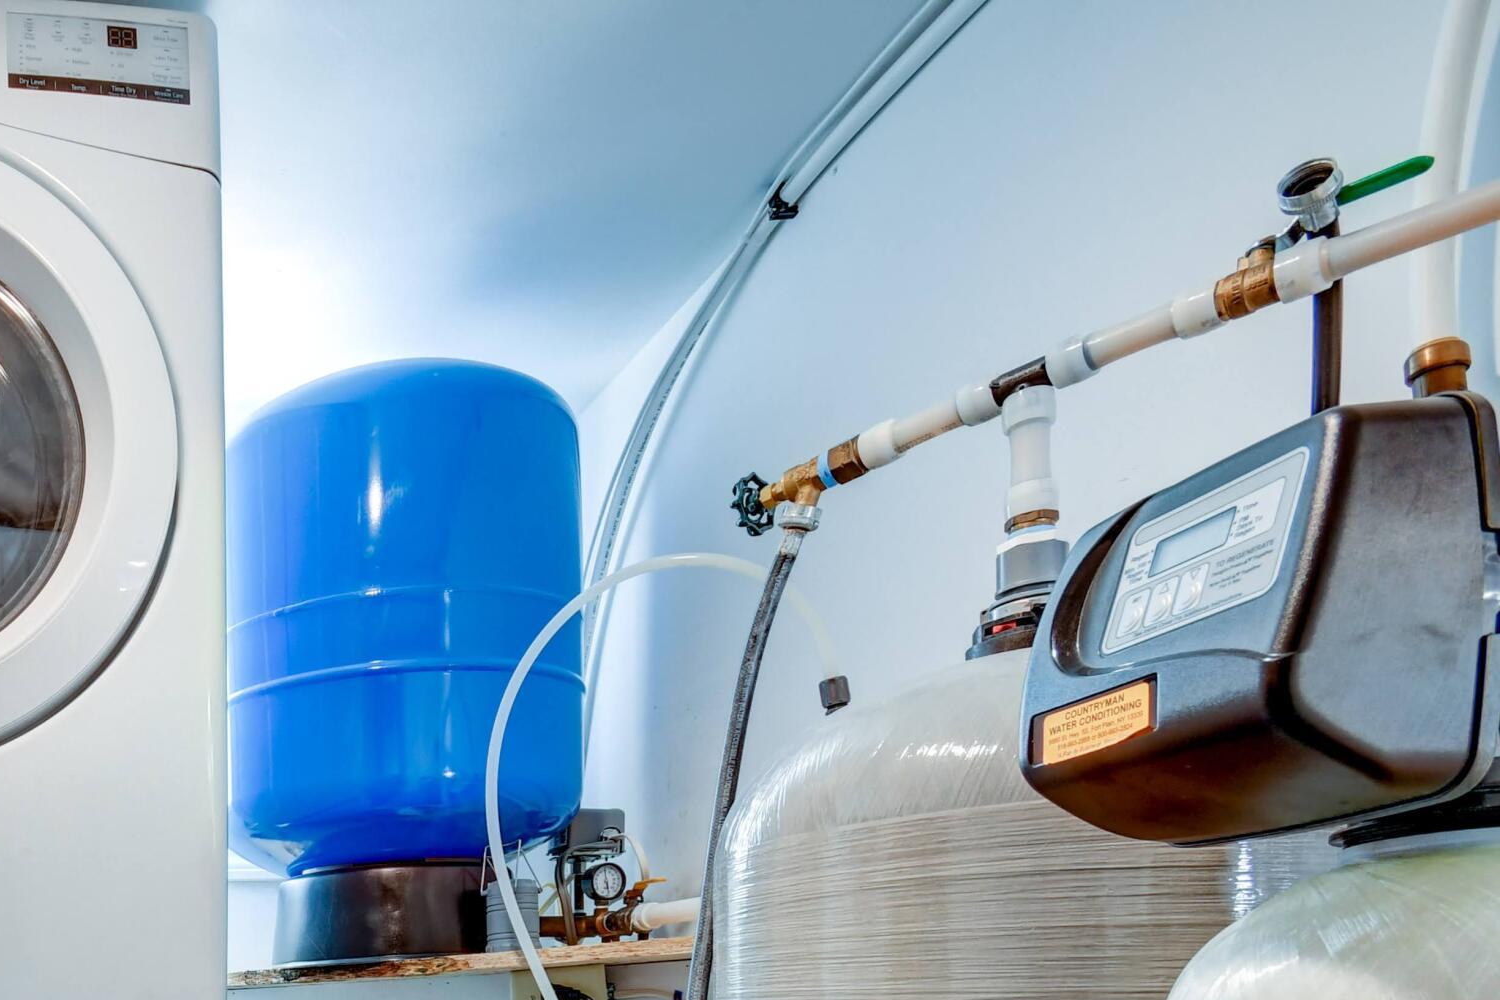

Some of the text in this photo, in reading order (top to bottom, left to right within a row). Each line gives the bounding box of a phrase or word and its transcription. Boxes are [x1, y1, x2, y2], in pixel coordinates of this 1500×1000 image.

[19, 78, 29, 87] Dry
[111, 85, 124, 93] Time
[125, 86, 136, 96] Dry
[1065, 694, 1125, 720] COUNTRYMAN
[1049, 699, 1142, 736] WATER CONDITIONING
